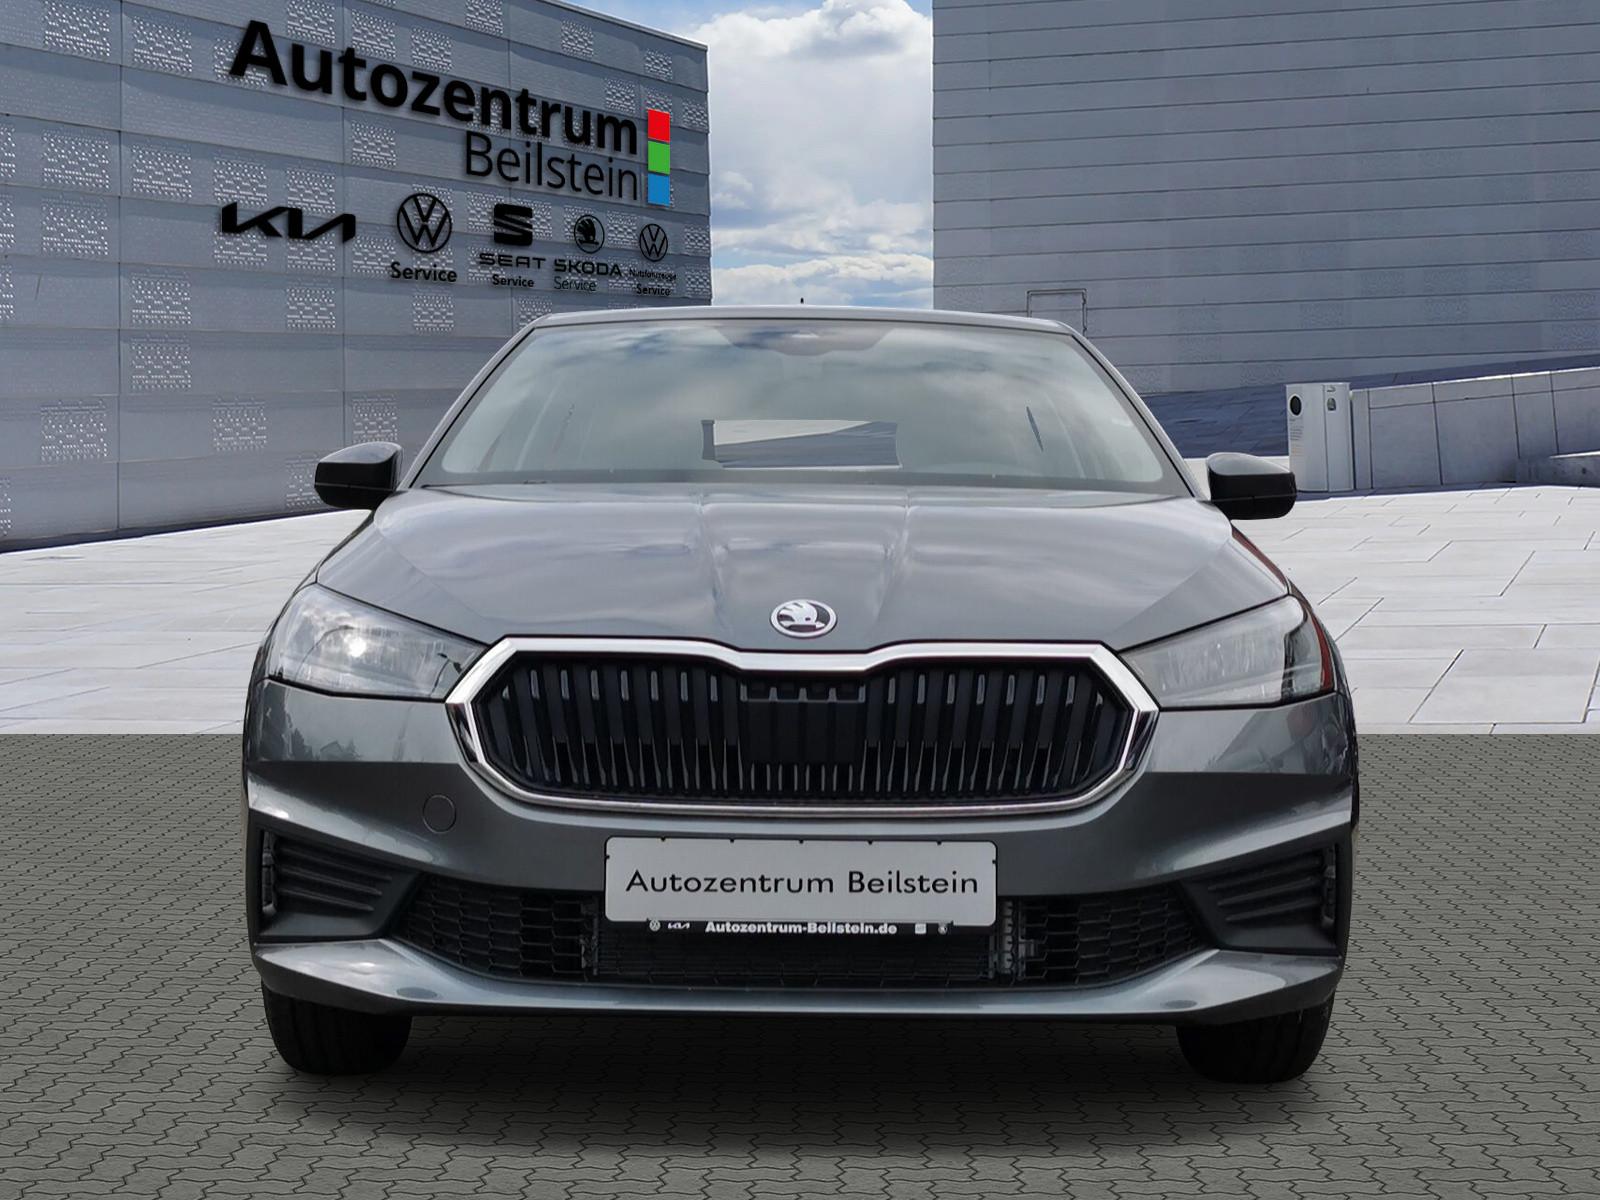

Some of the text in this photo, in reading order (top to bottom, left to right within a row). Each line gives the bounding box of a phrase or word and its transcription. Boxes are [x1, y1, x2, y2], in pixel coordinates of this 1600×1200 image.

[229, 20, 638, 155] Autozentrum
[465, 131, 638, 200] Beilstein
[221, 202, 356, 243] KIA
[479, 253, 546, 269] SEAT
[390, 262, 457, 284] Service
[492, 275, 534, 288] Service
[554, 276, 597, 292] Service
[636, 284, 671, 297] Service
[626, 869, 978, 894] Autozentrum Beilstein
[705, 921, 897, 935] Autozentrum-Beilstein.de
